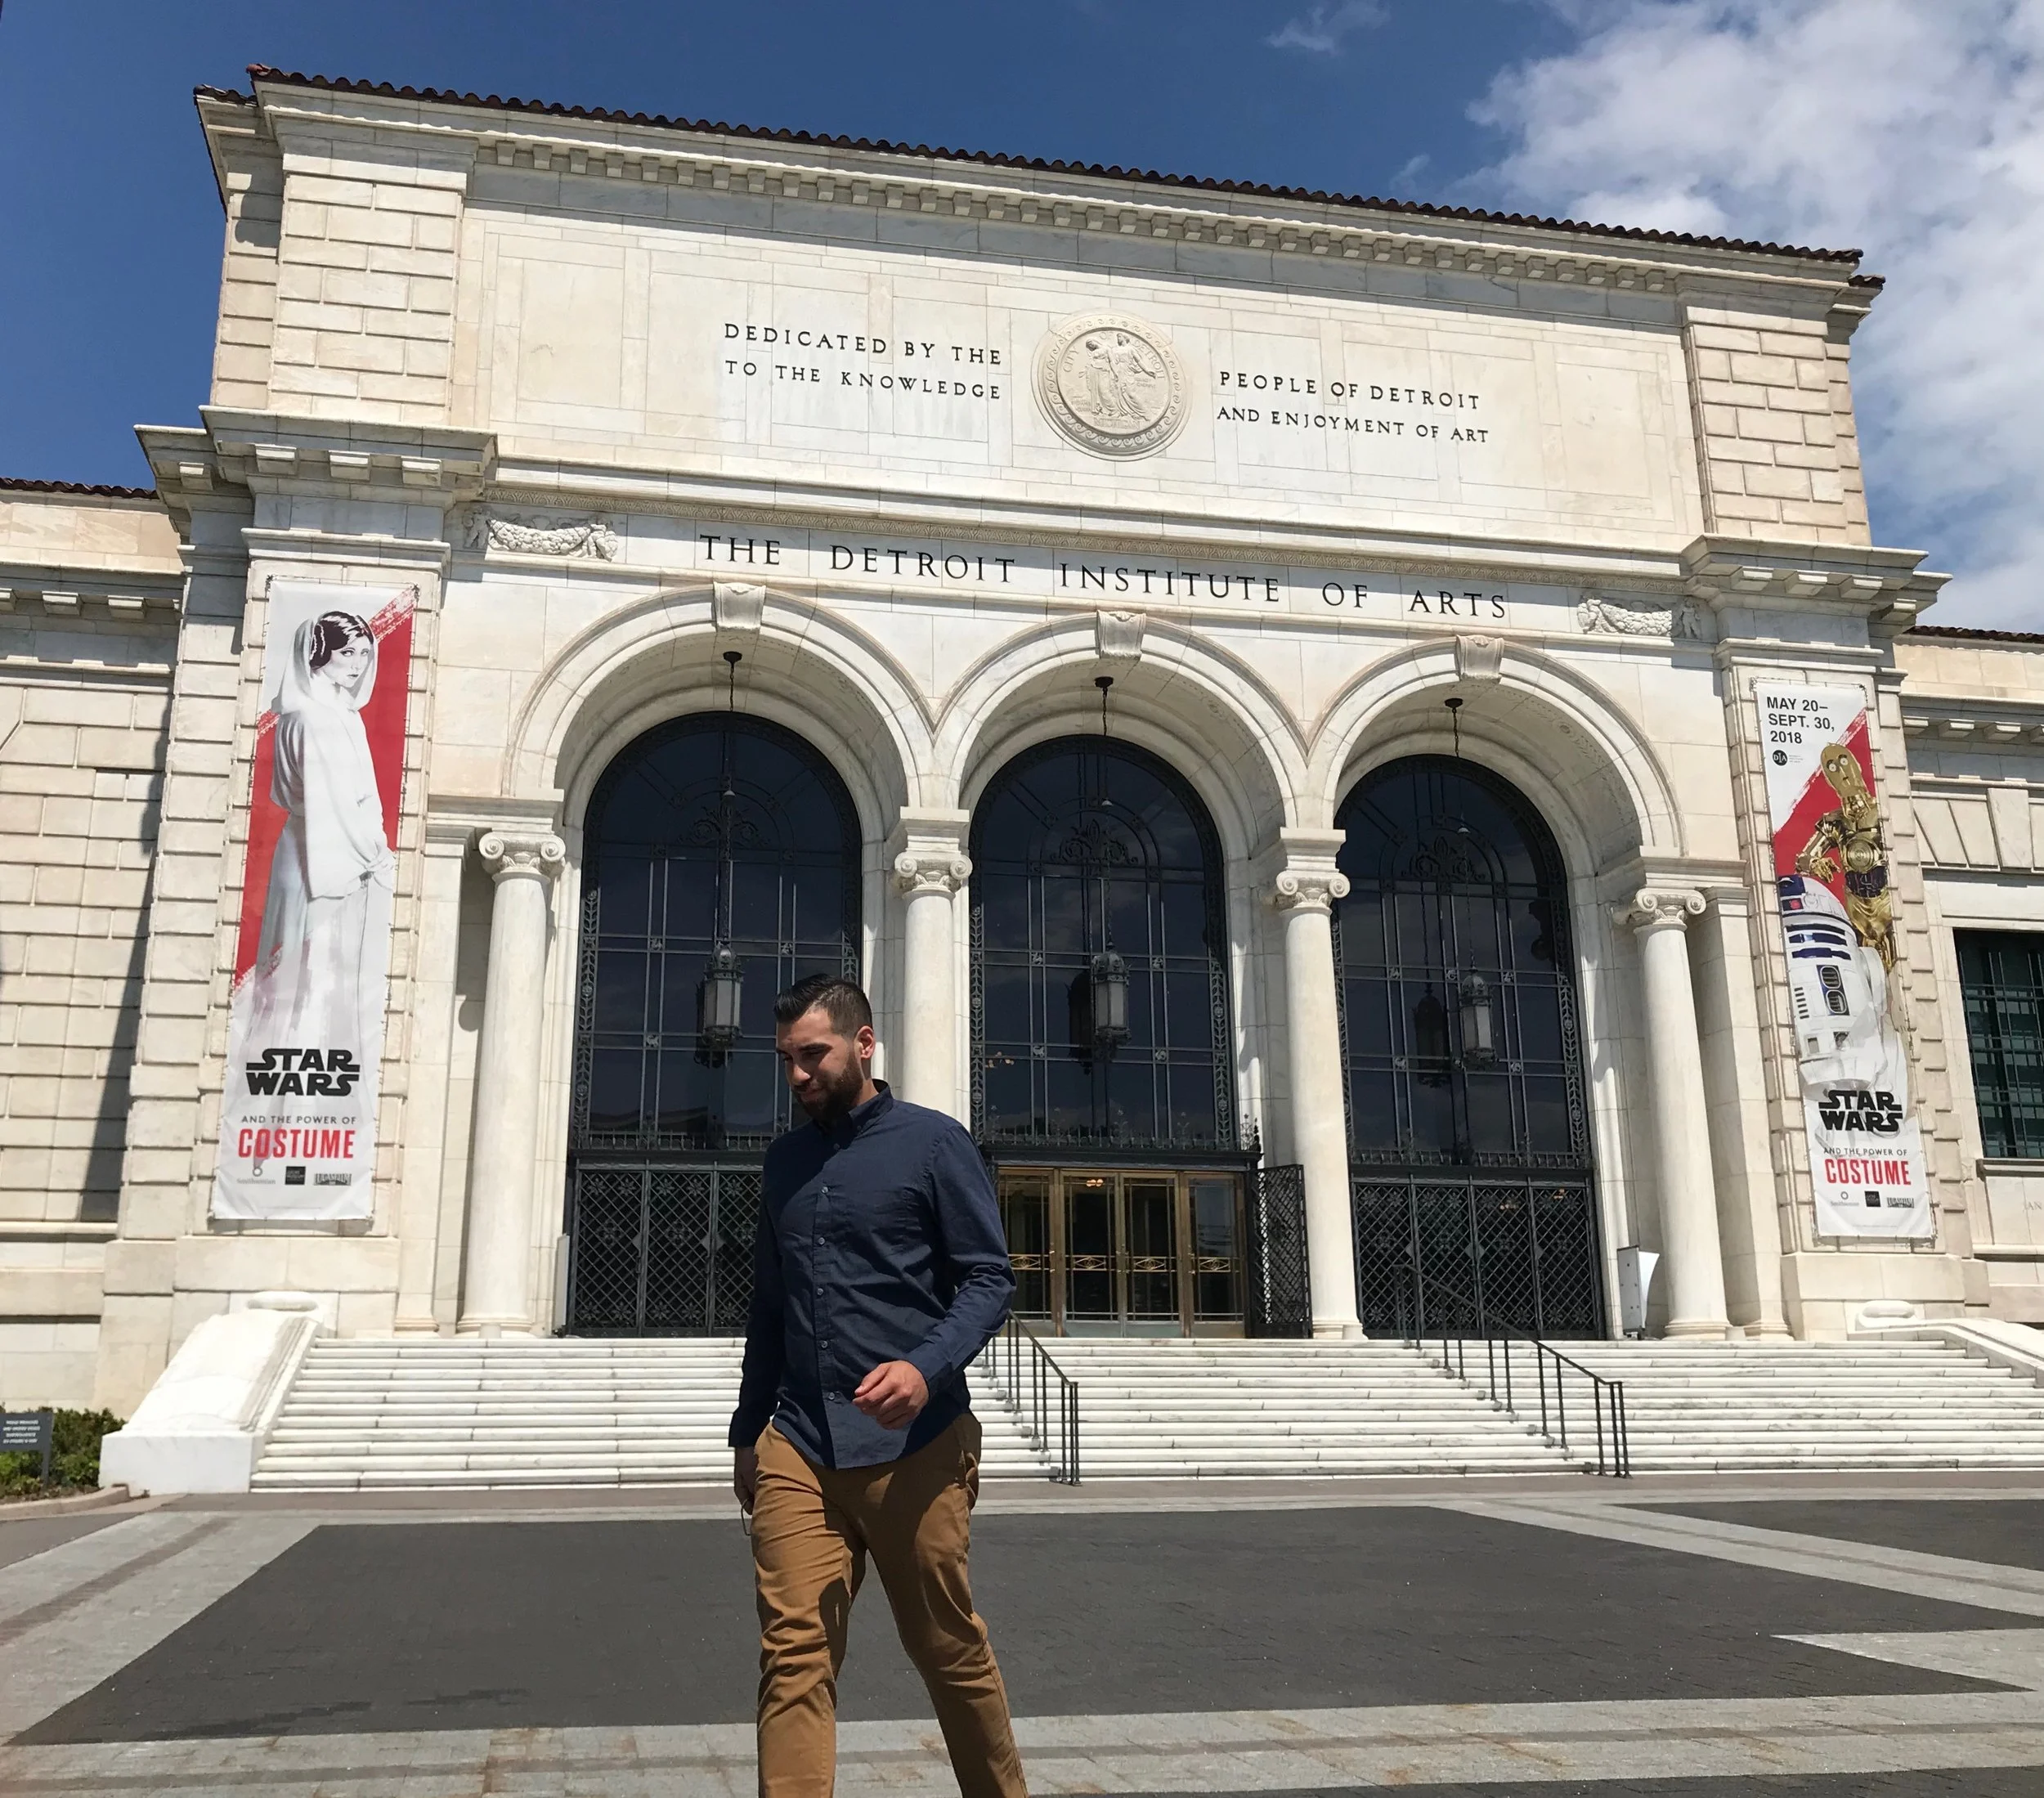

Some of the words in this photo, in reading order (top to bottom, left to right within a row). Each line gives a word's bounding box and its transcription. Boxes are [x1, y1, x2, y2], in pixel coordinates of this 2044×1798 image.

[724, 323, 886, 354] DEDICATED
[904, 341, 935, 358] BY
[951, 346, 1001, 365] THE
[1063, 347, 1079, 373] CITY
[725, 360, 757, 376] TO
[775, 365, 820, 383] THE
[841, 371, 1000, 400] KNOWLEDGE
[1220, 371, 1316, 394] PEOPLE
[1330, 382, 1358, 397] OF
[1369, 385, 1479, 410] DETROIT
[1217, 406, 1260, 422] AND
[1271, 410, 1405, 435] ENJOYMENT
[1416, 424, 1439, 438] OF
[1450, 428, 1489, 442] ART
[699, 534, 780, 565] THE
[830, 544, 1015, 582] DETROIT
[1060, 563, 1279, 602] INSTITUTE
[1322, 582, 1368, 608] OF
[1408, 590, 1504, 618] ARTS
[1766, 696, 1797, 711] MAY
[1768, 713, 1810, 728] SEPT.
[1813, 716, 1835, 732] 30,
[1770, 730, 1803, 744] 2018
[1773, 751, 1787, 764] DIA
[246, 1048, 360, 1072] STAR
[246, 1072, 360, 1096] WARS
[1818, 1089, 1903, 1111] STAR
[241, 1115, 267, 1124] AND
[271, 1115, 291, 1124] THE
[296, 1115, 337, 1125] POWER
[343, 1116, 356, 1125] OF
[1819, 1110, 1903, 1132] WARS
[238, 1128, 356, 1159] COSTUME
[1863, 1148, 1894, 1156] POWER
[1824, 1159, 1912, 1186] COSTUME
